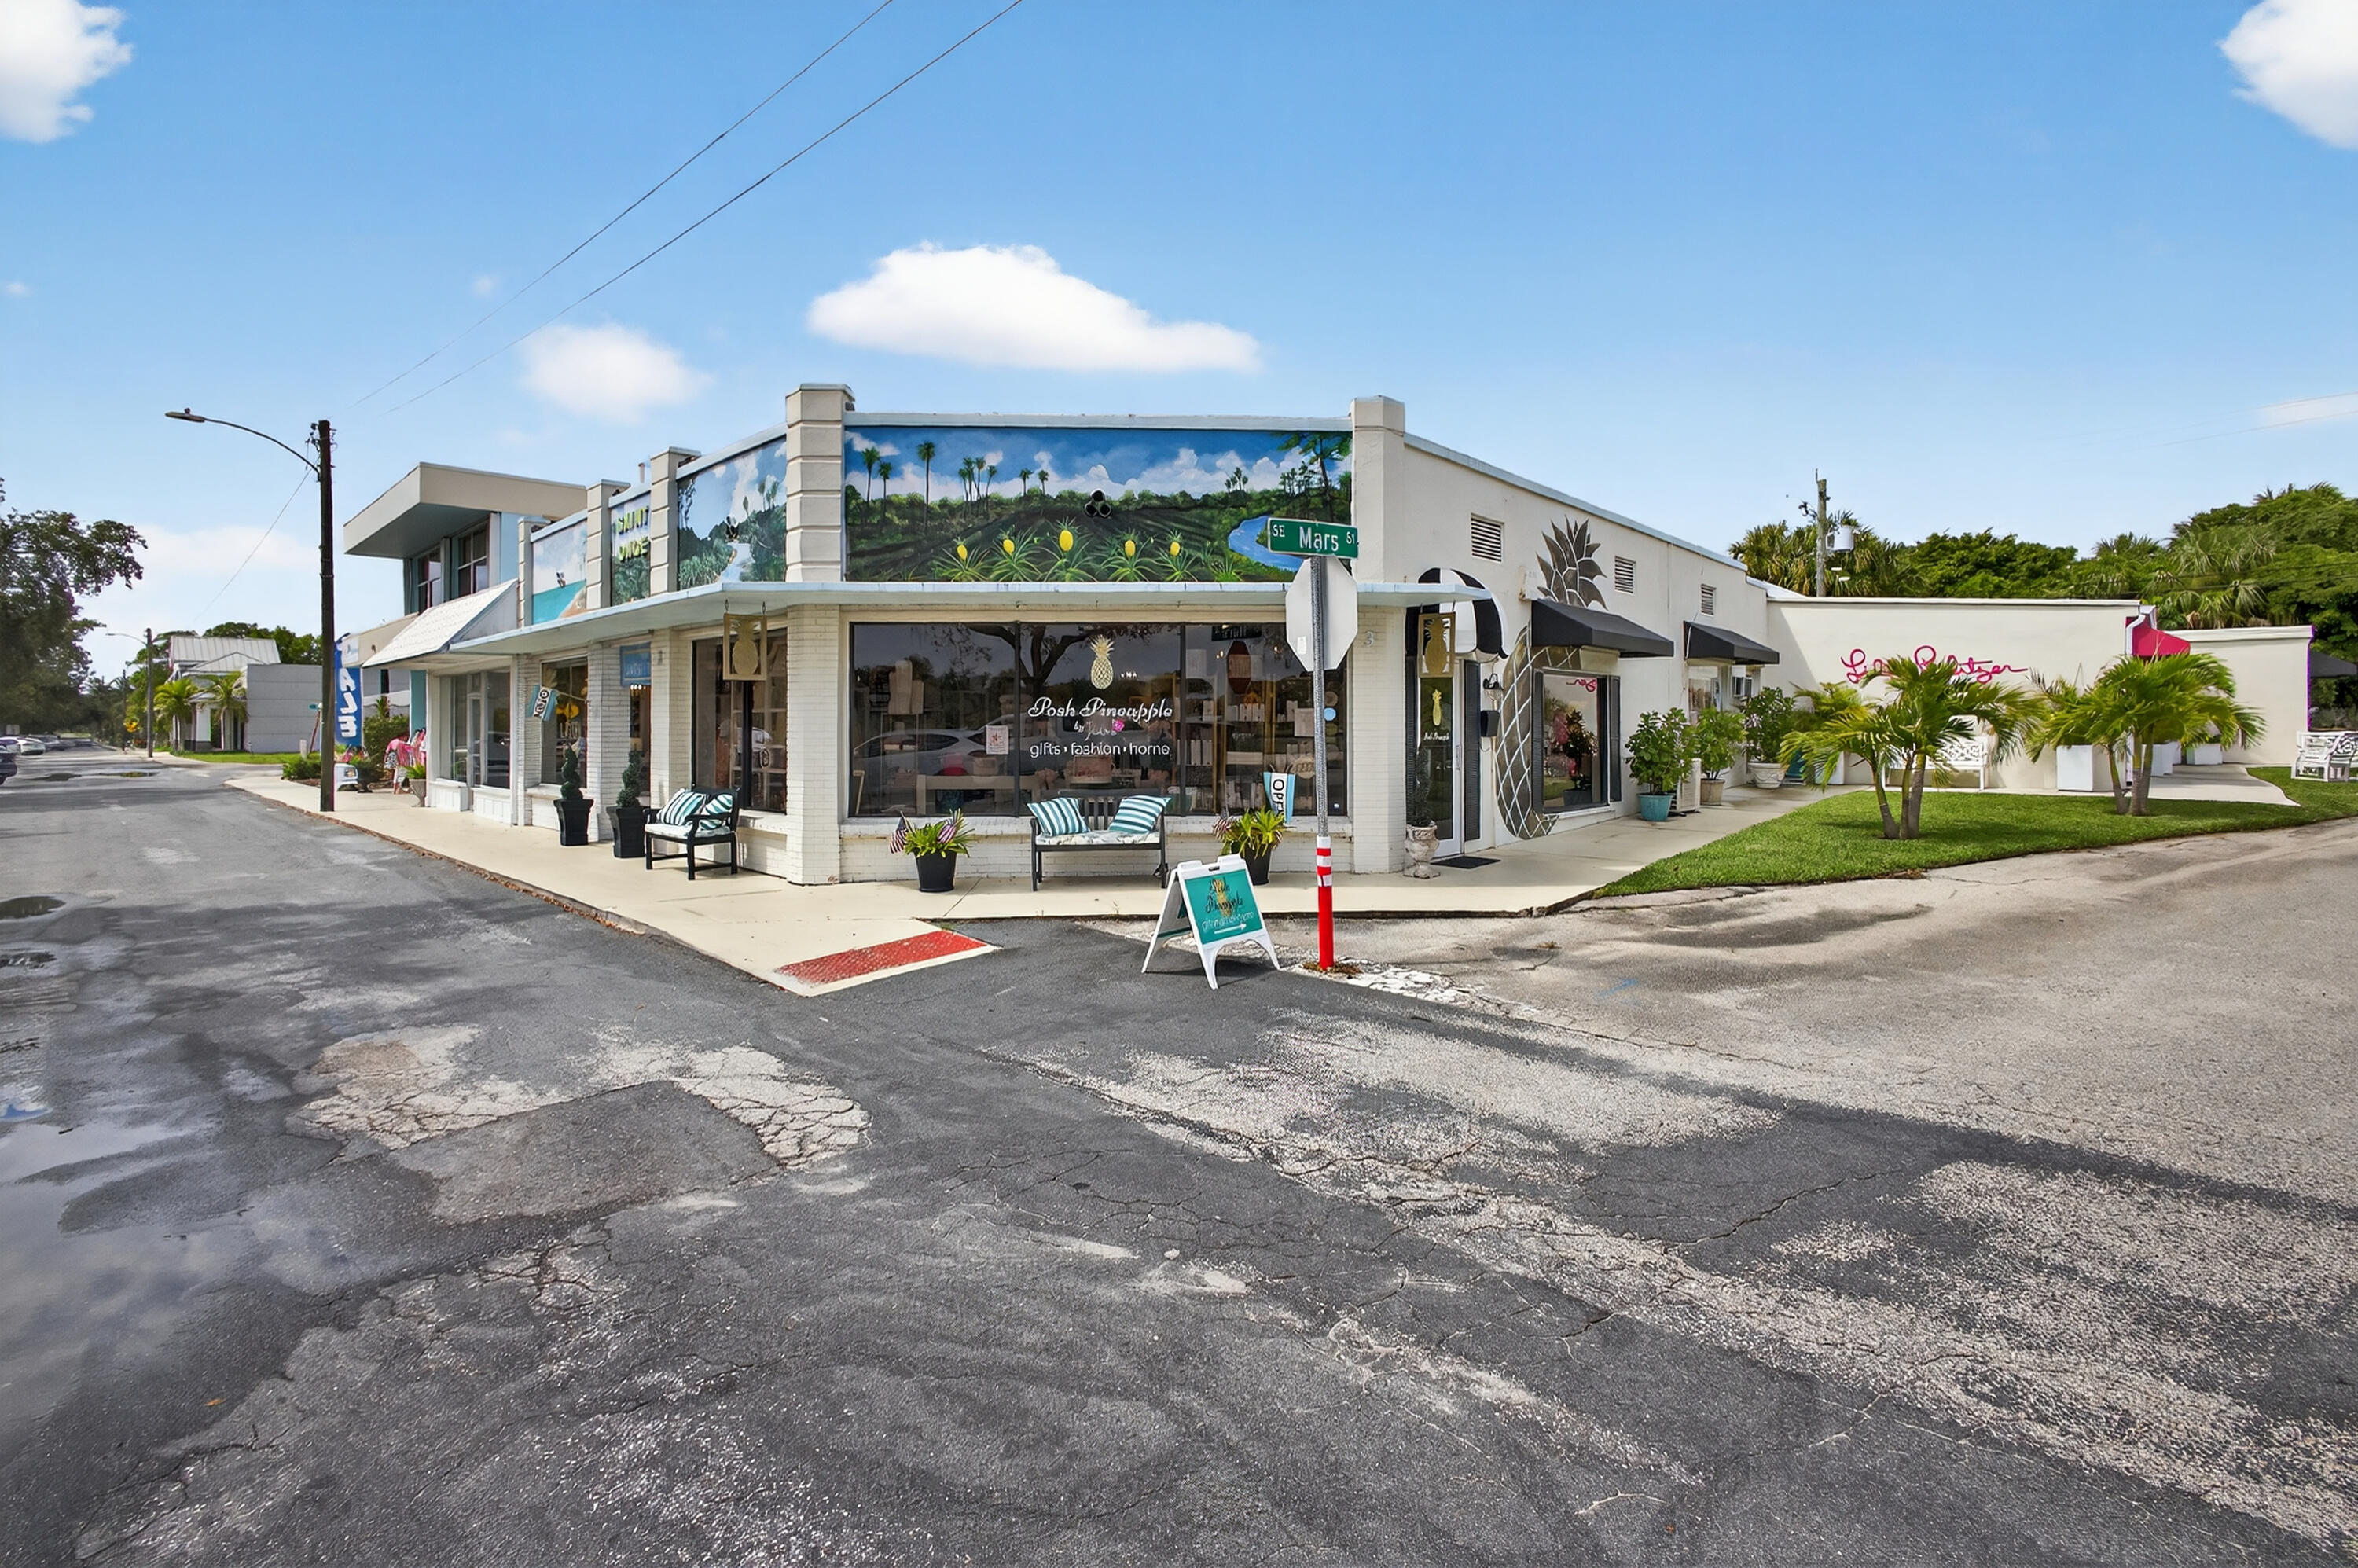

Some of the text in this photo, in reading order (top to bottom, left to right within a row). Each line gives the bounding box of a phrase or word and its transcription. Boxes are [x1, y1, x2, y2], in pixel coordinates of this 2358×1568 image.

[1273, 524, 1285, 537] SE
[1299, 526, 1339, 551] Mars
[1027, 696, 1173, 722] Posh Pineapple
[1030, 742, 1170, 758] gifts fashion home
